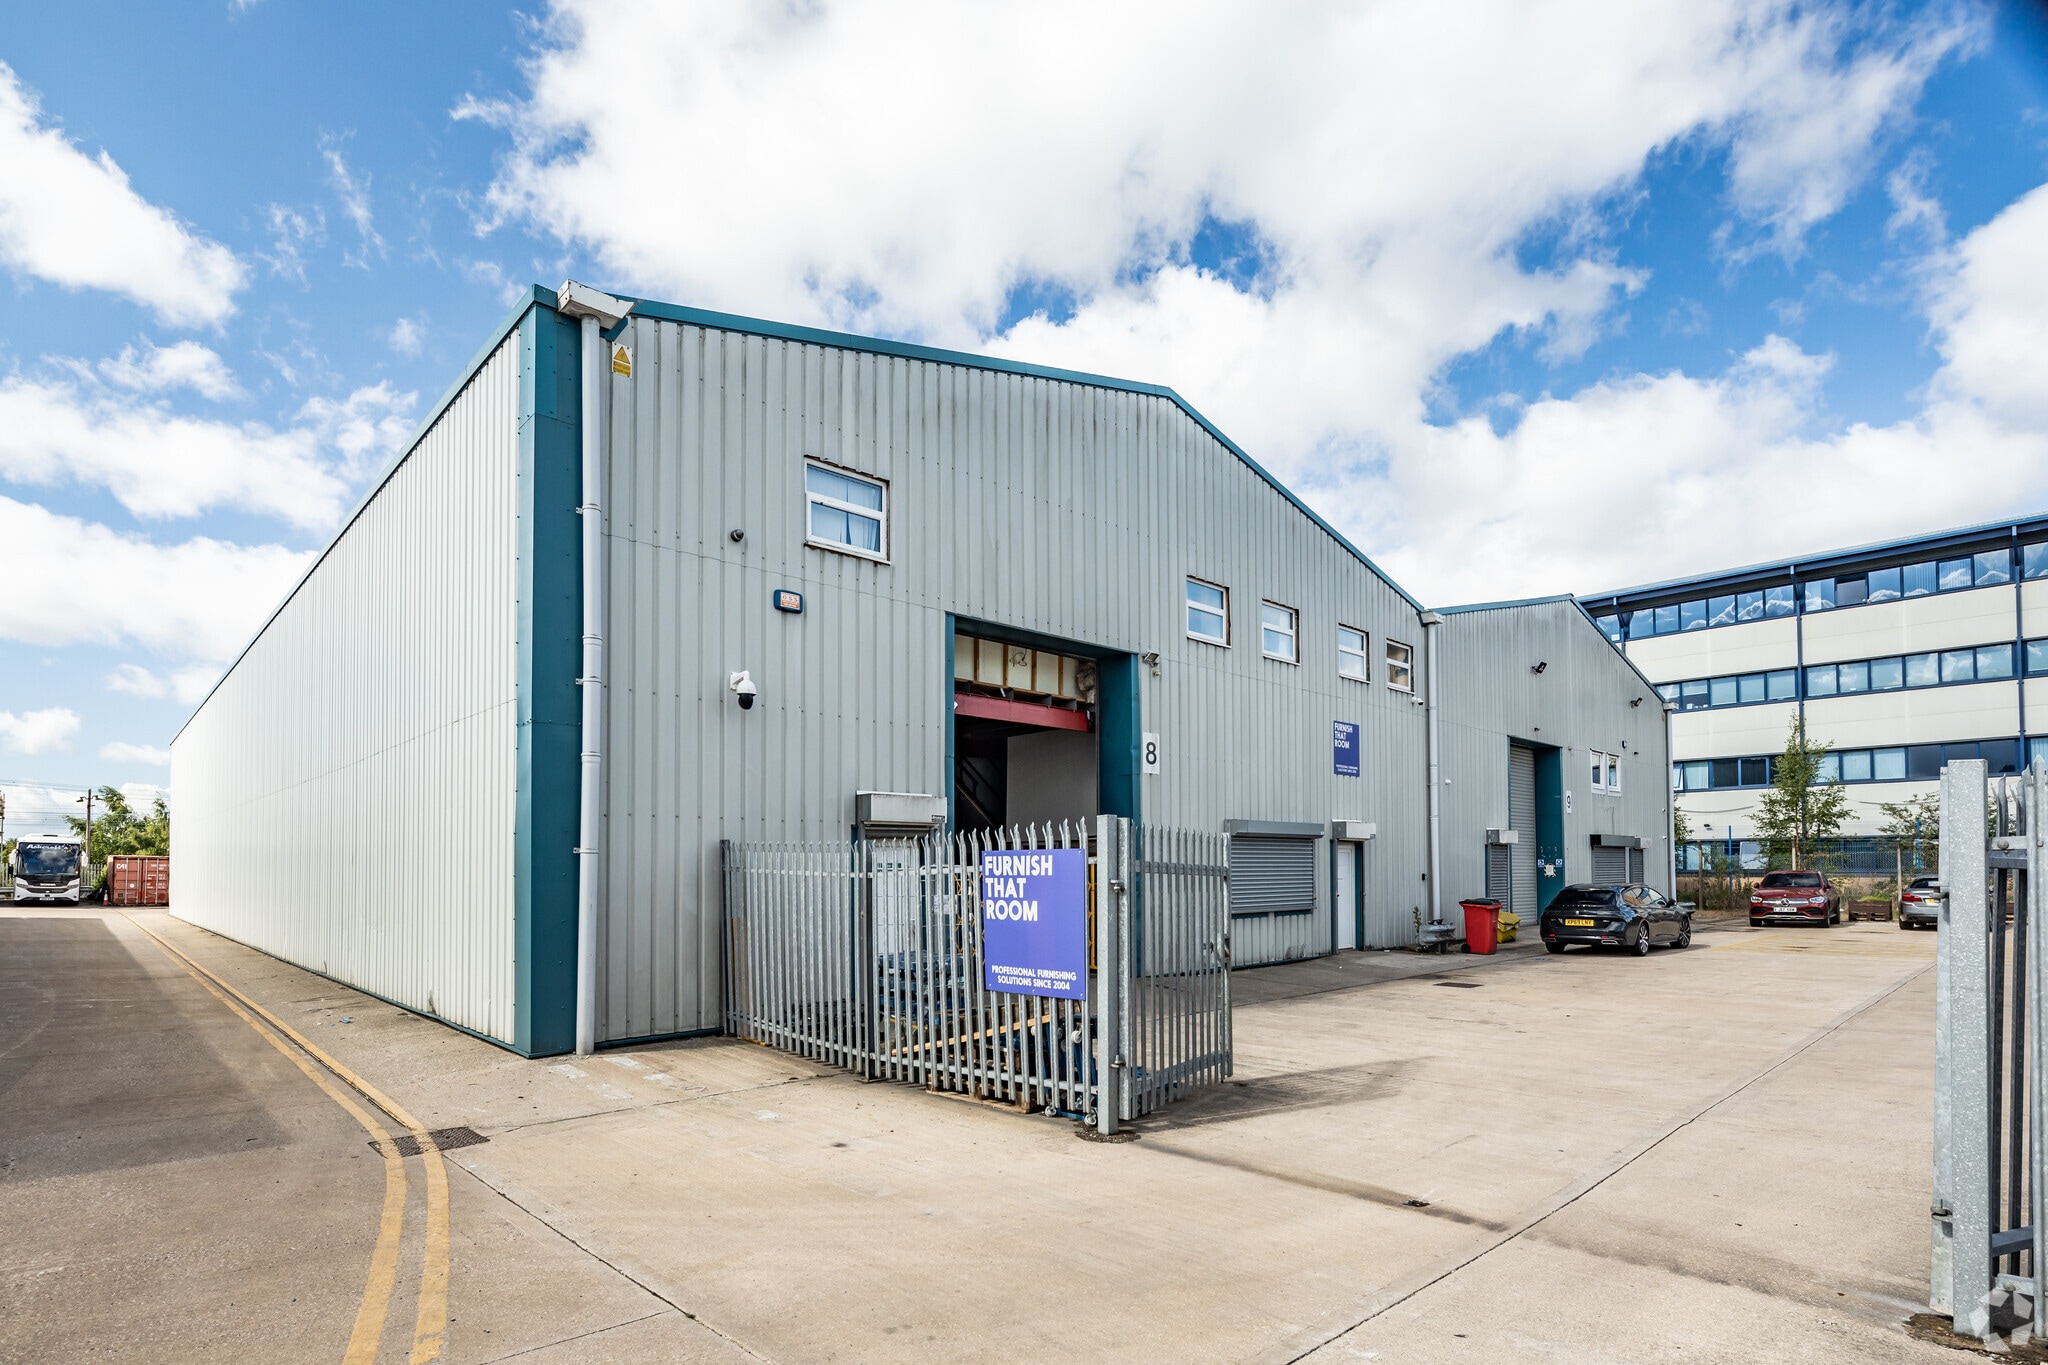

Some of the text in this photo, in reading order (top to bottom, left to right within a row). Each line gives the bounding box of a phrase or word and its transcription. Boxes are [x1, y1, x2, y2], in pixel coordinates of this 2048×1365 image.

[1335, 739, 1350, 749] ROOM
[1146, 742, 1157, 765] 8
[1566, 795, 1571, 808] 9
[984, 855, 1053, 876] FURNISH
[985, 877, 1027, 898] THAT
[986, 900, 1038, 921] ROOM
[992, 965, 1077, 981] PROFESSIONAL FURNISHING
[998, 975, 1070, 991] SOLUTIONS SINCE 2004
